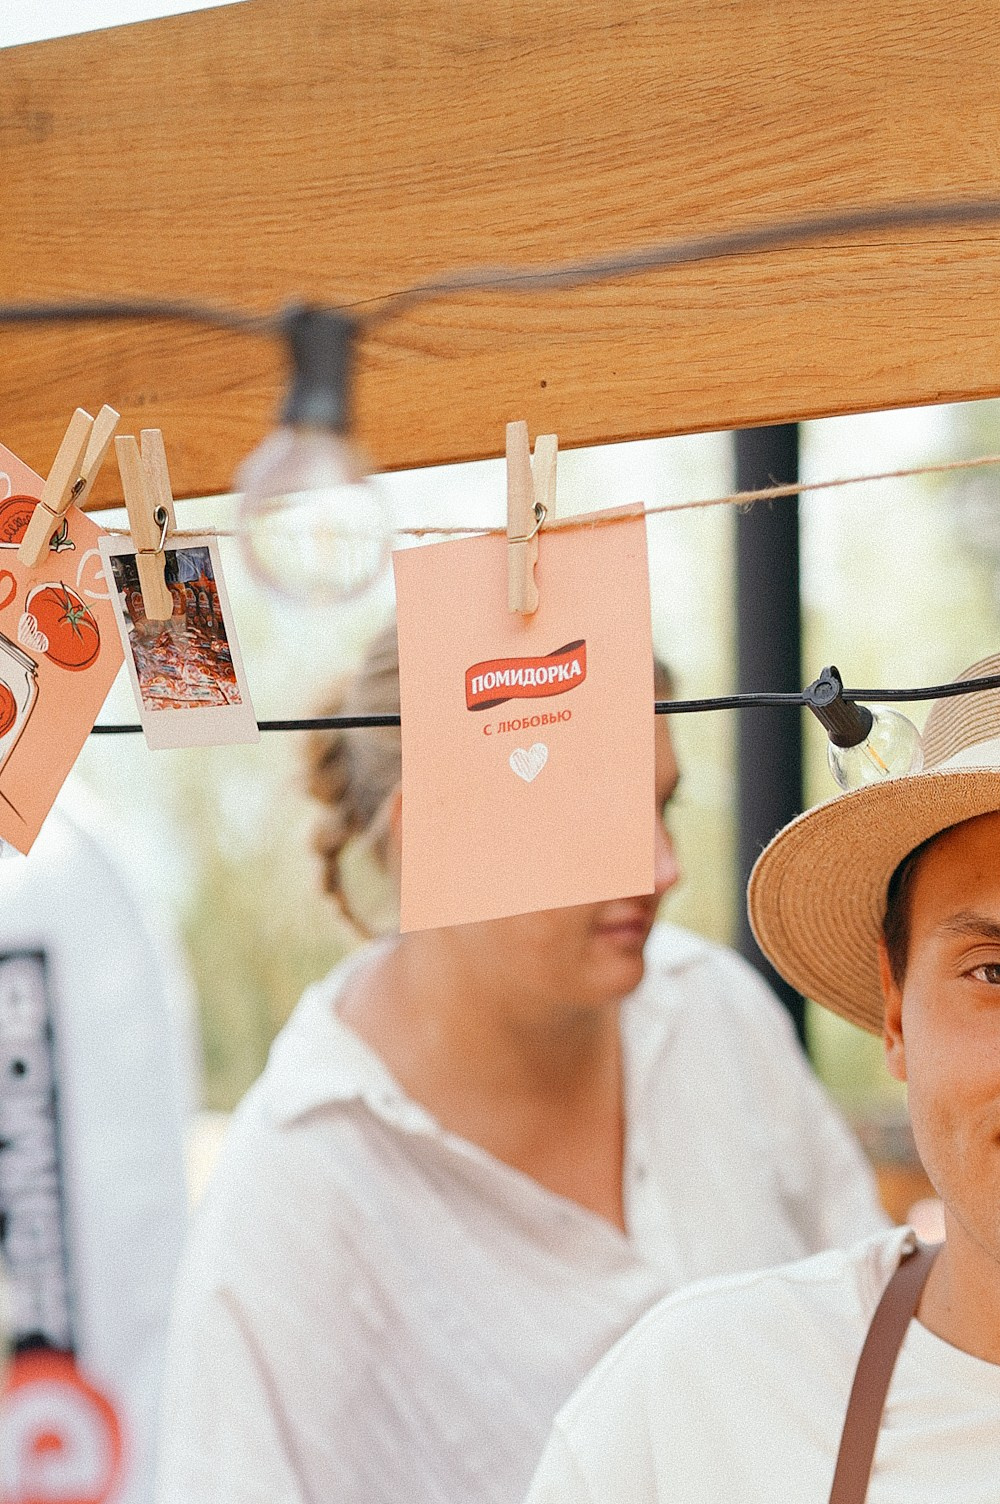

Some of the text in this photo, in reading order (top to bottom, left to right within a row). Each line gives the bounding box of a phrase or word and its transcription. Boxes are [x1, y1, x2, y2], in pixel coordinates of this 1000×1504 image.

[471, 659, 582, 695] ПОМИДОРКА
[483, 709, 572, 736] С ЛЮБОВЬЮ
